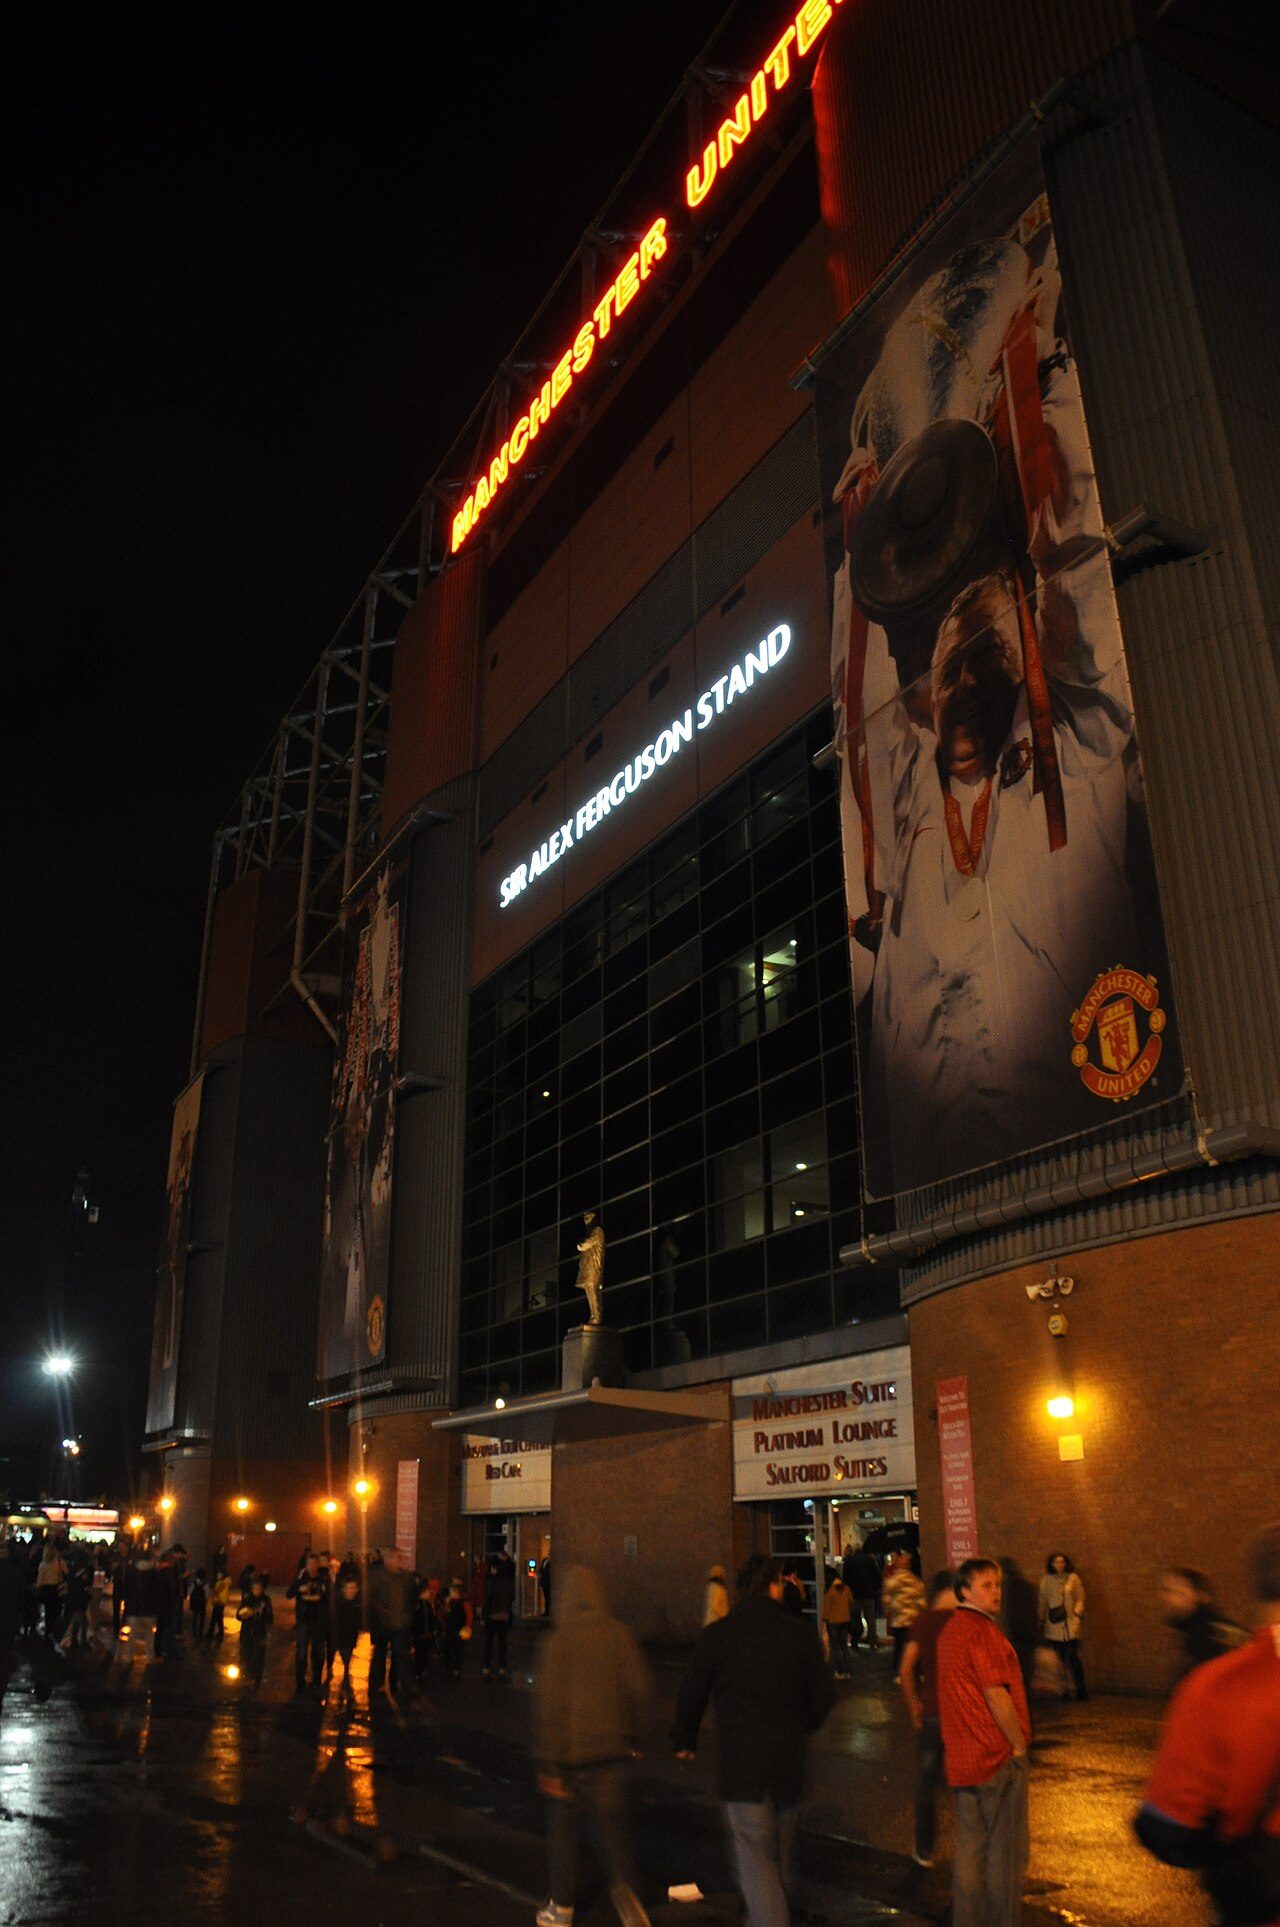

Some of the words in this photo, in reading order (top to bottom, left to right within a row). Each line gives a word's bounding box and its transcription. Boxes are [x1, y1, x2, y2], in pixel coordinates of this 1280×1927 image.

[452, 217, 667, 553] MANCHESTER
[686, 0, 843, 208] UNITE
[500, 863, 527, 907] SIR
[529, 819, 573, 882] ALEX
[576, 709, 693, 840] FERGUSON
[697, 624, 791, 730] STAND
[1078, 973, 1153, 1032] MANCHESTER
[1097, 1059, 1151, 1093] UNITED
[752, 1390, 847, 1421] MANCHESTER
[851, 1381, 898, 1406] SUITE
[754, 1428, 823, 1454] PLATINUM
[832, 1418, 897, 1444] LOUNGE
[766, 1462, 830, 1486] SALFORD
[833, 1455, 888, 1481] SUITES
